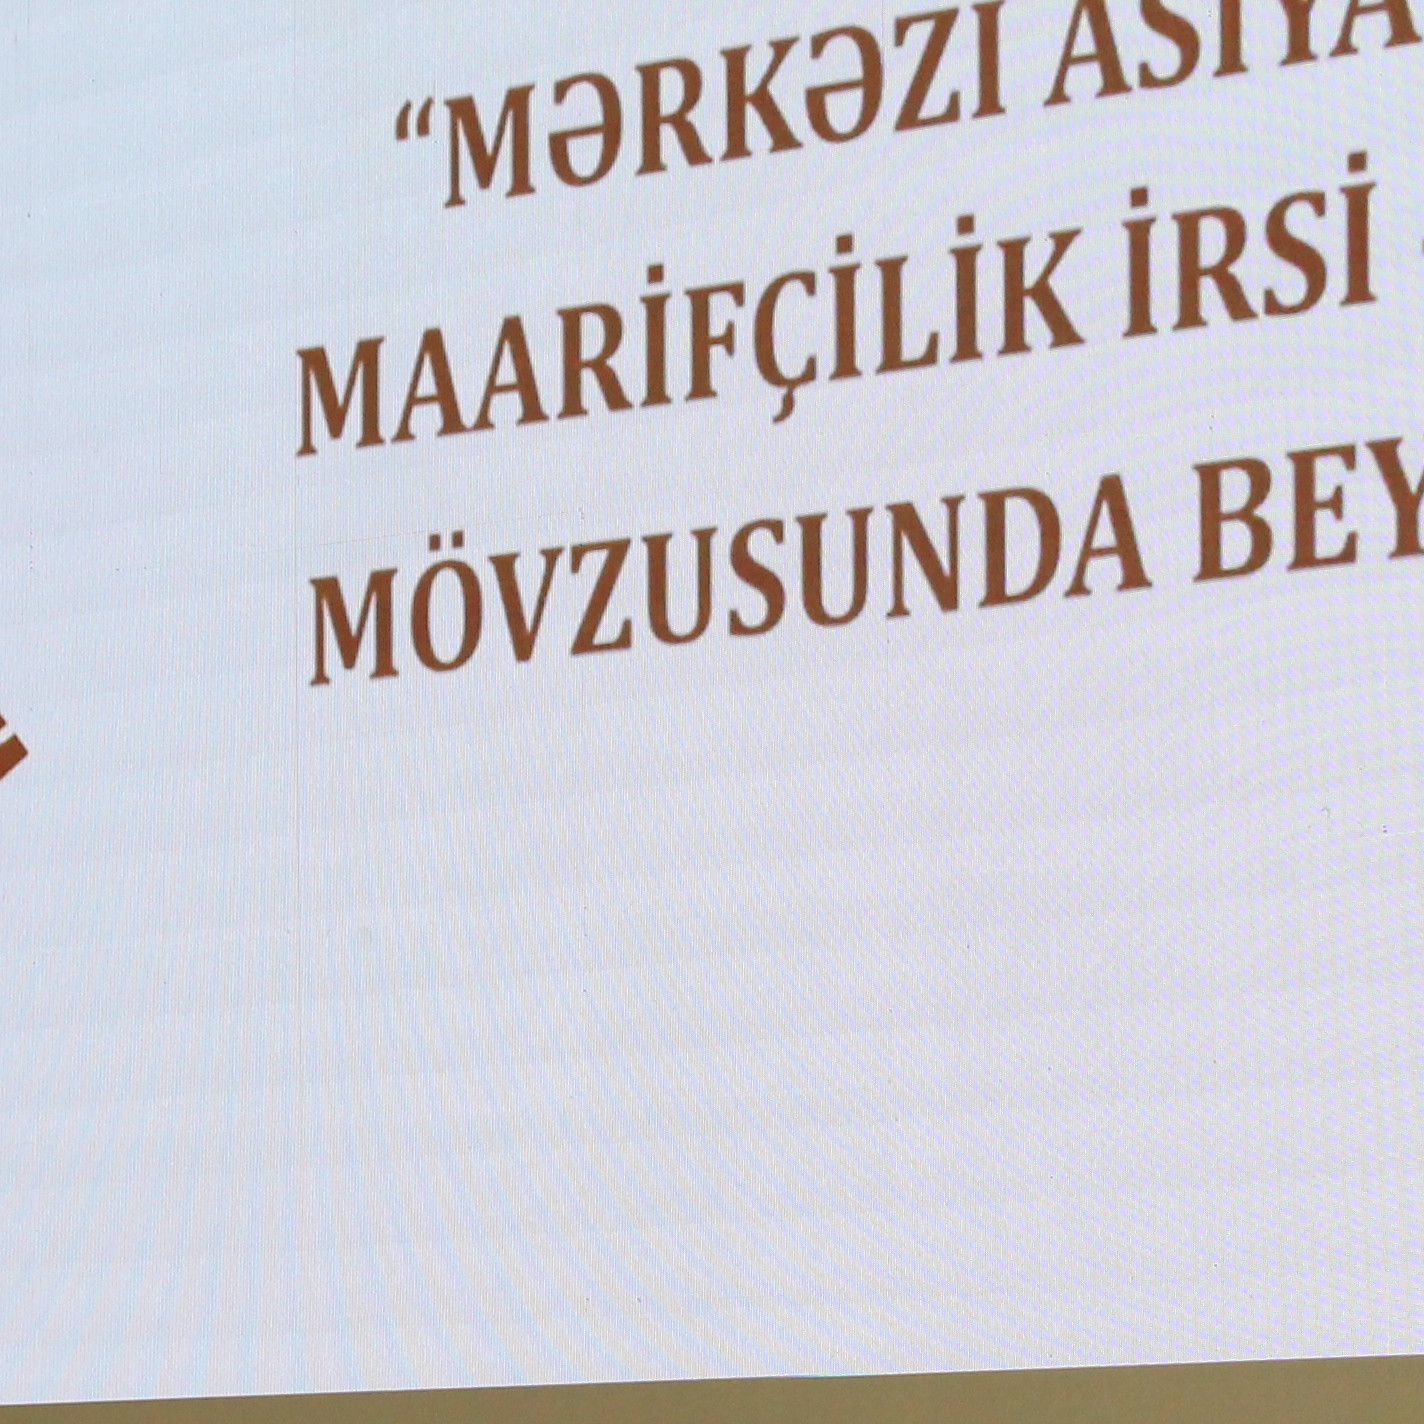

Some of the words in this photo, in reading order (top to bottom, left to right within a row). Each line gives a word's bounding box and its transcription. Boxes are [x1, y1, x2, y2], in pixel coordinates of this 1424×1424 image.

[297, 214, 1084, 457] MAARİFÇİLİK
[1123, 150, 1378, 338] İRSİ
[310, 474, 1153, 686] MÖVZUSUNDA
